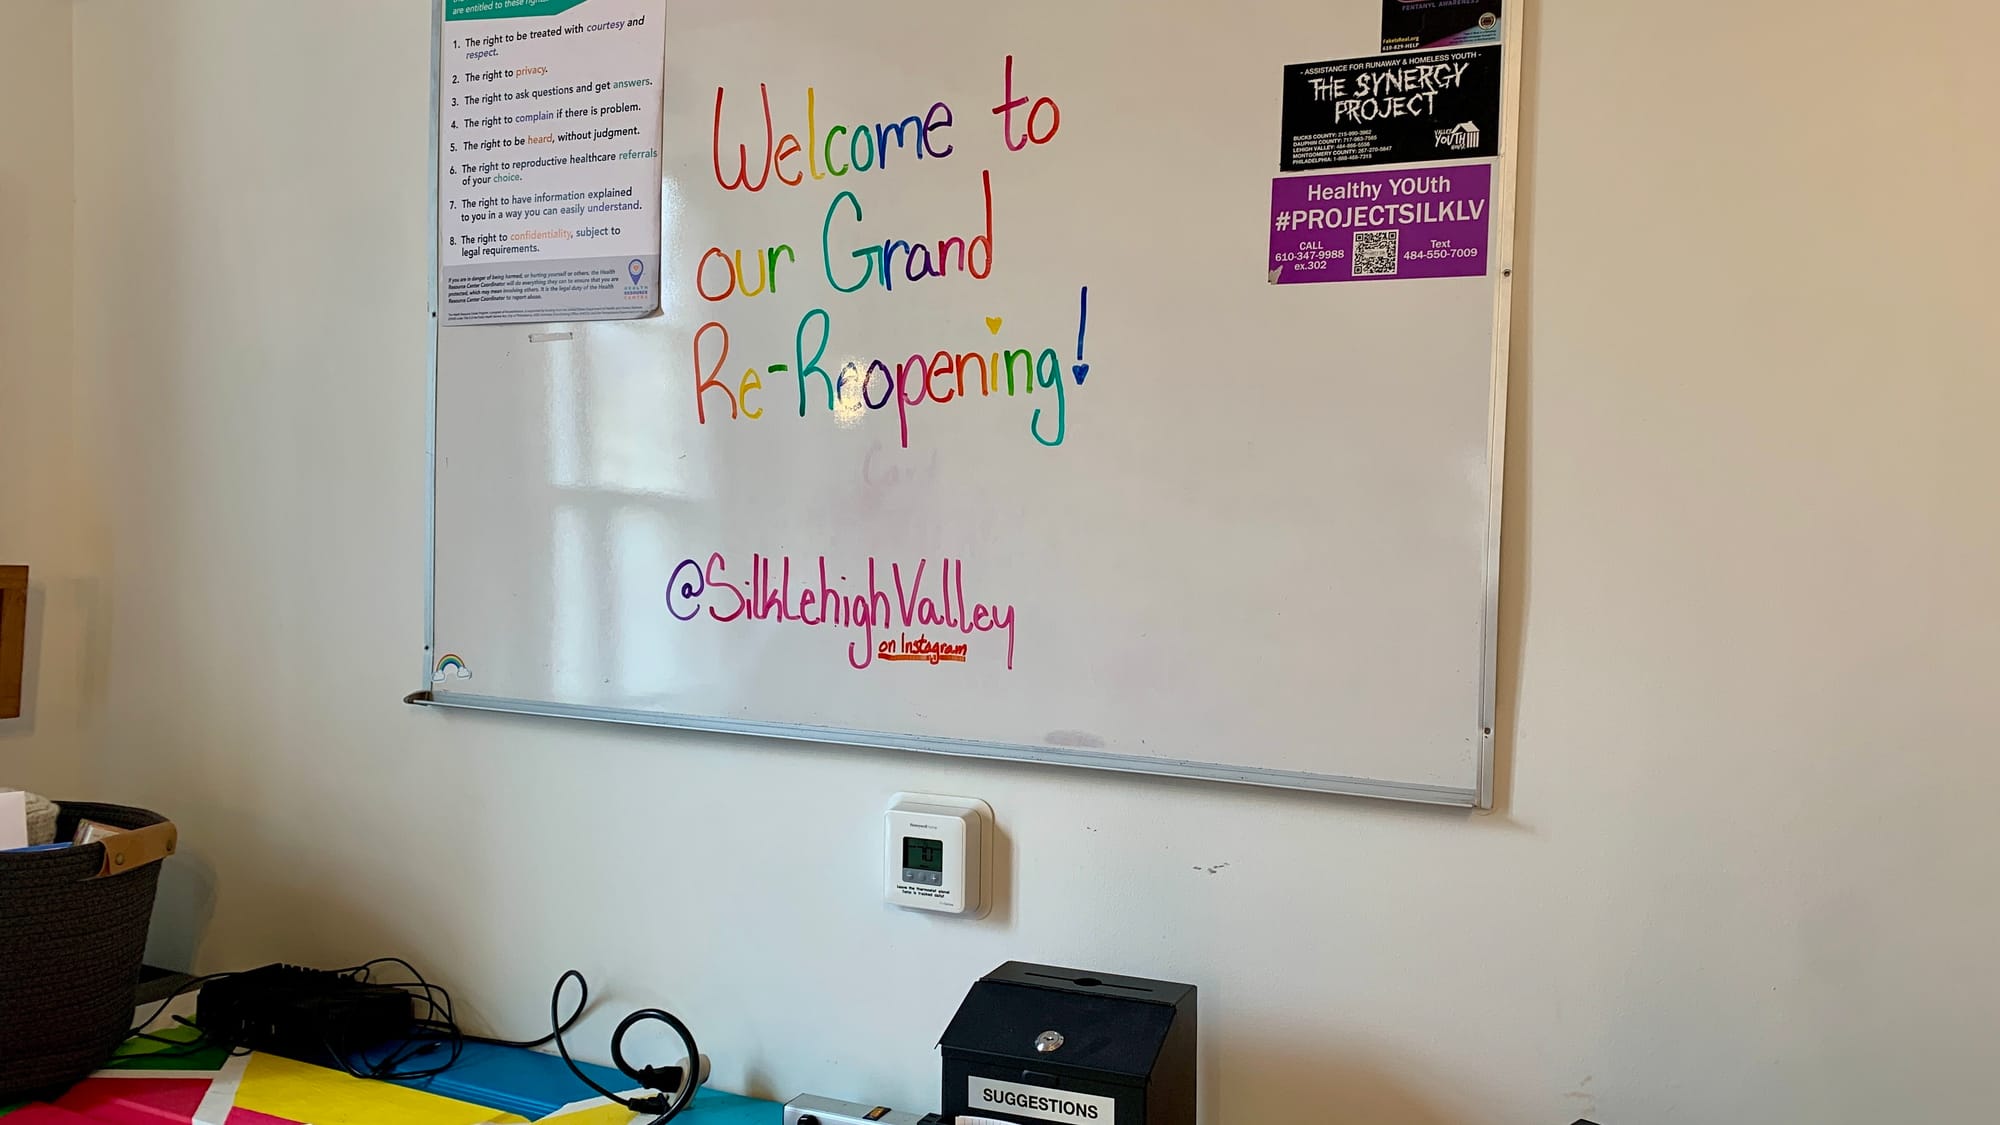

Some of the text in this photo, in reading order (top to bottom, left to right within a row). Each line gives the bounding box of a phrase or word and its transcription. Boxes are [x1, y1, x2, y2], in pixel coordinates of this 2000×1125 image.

[452, 7, 464, 15] are
[465, 3, 493, 13] entitled
[504, 0, 524, 8] these
[453, 40, 461, 48] 1.
[465, 37, 481, 47] The
[483, 34, 503, 47] right
[516, 32, 527, 40] be
[530, 26, 562, 39] treated
[564, 23, 584, 35] with
[586, 20, 625, 32] courtesy
[627, 15, 645, 27] and
[465, 48, 499, 61] respect.
[1304, 65, 1348, 75] ASSISTANCE
[1349, 63, 1364, 71] FOR
[1365, 59, 1401, 69] RUNAWAY
[1409, 55, 1449, 65] HOMELESS
[1451, 51, 1477, 61] YOUTH
[452, 65, 548, 84] 2. The right to privacy.
[1308, 62, 1470, 101] THE SYNERGY
[451, 78, 653, 107] 3. The right to ask questions and get answers.
[451, 102, 641, 129] 4. The right to complain if there is problem.
[1334, 91, 1438, 125] PROJECT
[712, 54, 1061, 192] Welcome to
[450, 126, 640, 152] 5. The right to be heard, without judgment.
[1435, 132, 1466, 148] YOUTH
[450, 148, 658, 175] 6. The right to reproductive healthcare referrals
[462, 172, 523, 187] of your choice.
[1308, 176, 1451, 202] Healthy YOUth
[450, 186, 632, 210] 7. The right to have information explained
[461, 200, 643, 223] to you in a way you can easily understand.
[1275, 199, 1485, 232] #PROJECTSILKLV
[449, 226, 621, 246] 8. The right to confidentiality, subject to
[696, 169, 993, 302] our Grand
[1299, 241, 1324, 250] CALL
[1431, 239, 1451, 249] Text
[461, 244, 540, 258] legal requirements.
[1275, 249, 1345, 262] 610-347-9988
[1403, 248, 1478, 261] 484-550-7009
[1294, 260, 1327, 271] ex.302
[879, 633, 968, 665] on Instagram
[983, 1088, 1098, 1119] SUGGESTIONS
